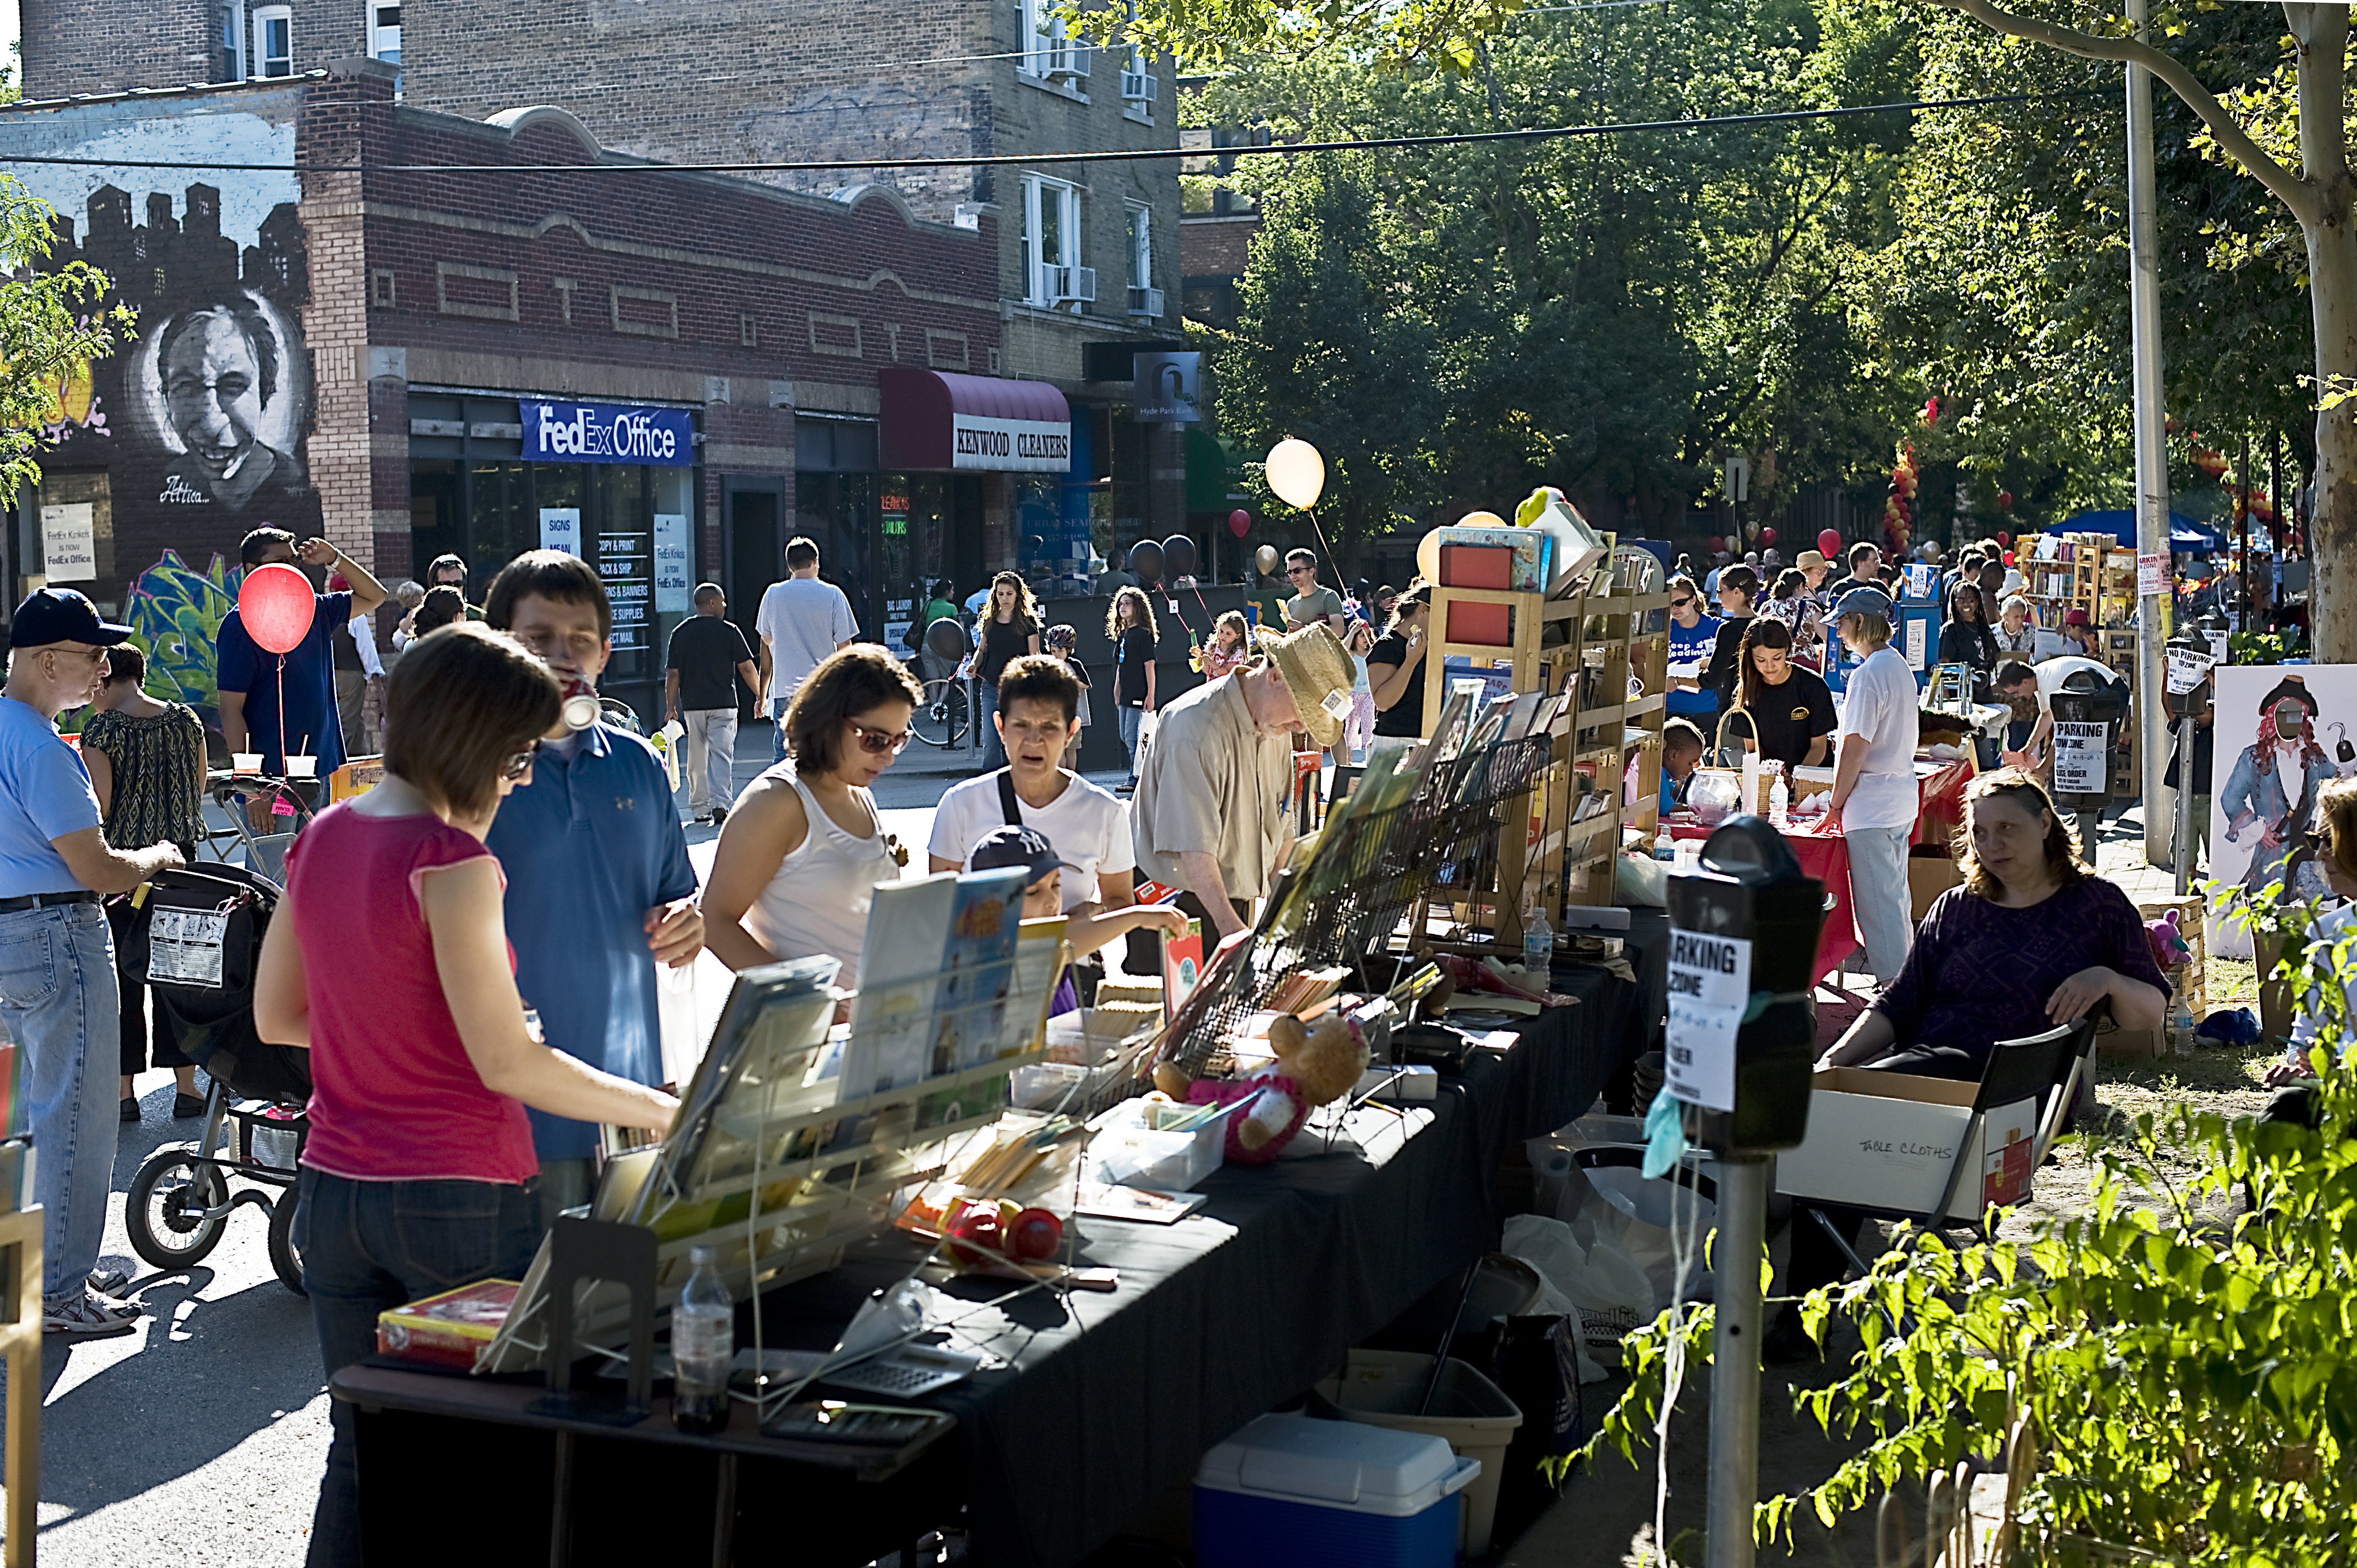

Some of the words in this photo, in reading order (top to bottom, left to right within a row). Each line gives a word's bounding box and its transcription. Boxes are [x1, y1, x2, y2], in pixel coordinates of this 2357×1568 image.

[1140, 407, 1158, 416] Hyde
[540, 406, 612, 455] FedEx
[614, 414, 675, 458] Office
[957, 428, 1009, 457] KENWOOD
[1017, 433, 1068, 459] CLEANERS
[549, 519, 570, 531] SIGNS
[48, 531, 66, 540] FedEx
[59, 543, 64, 551] is
[613, 540, 618, 550] &
[619, 540, 635, 550] PRINT
[48, 555, 68, 564] FedEx
[613, 563, 618, 574] &
[619, 563, 632, 574] SHIP
[658, 578, 671, 588] FedEx
[604, 586, 616, 598] GNS
[617, 586, 622, 596] &
[622, 585, 647, 596] BANNERS
[618, 608, 643, 619] SUPPLIES
[620, 632, 633, 643] MAIL
[2169, 649, 2179, 657] NO
[2057, 723, 2103, 737] PARKING
[2055, 738, 2068, 748] TOW
[2068, 739, 2084, 749] ZONE
[1675, 935, 1736, 974] RKING
[1861, 1140, 1892, 1153] TABLE
[1900, 1143, 1952, 1159] CLOTHS
